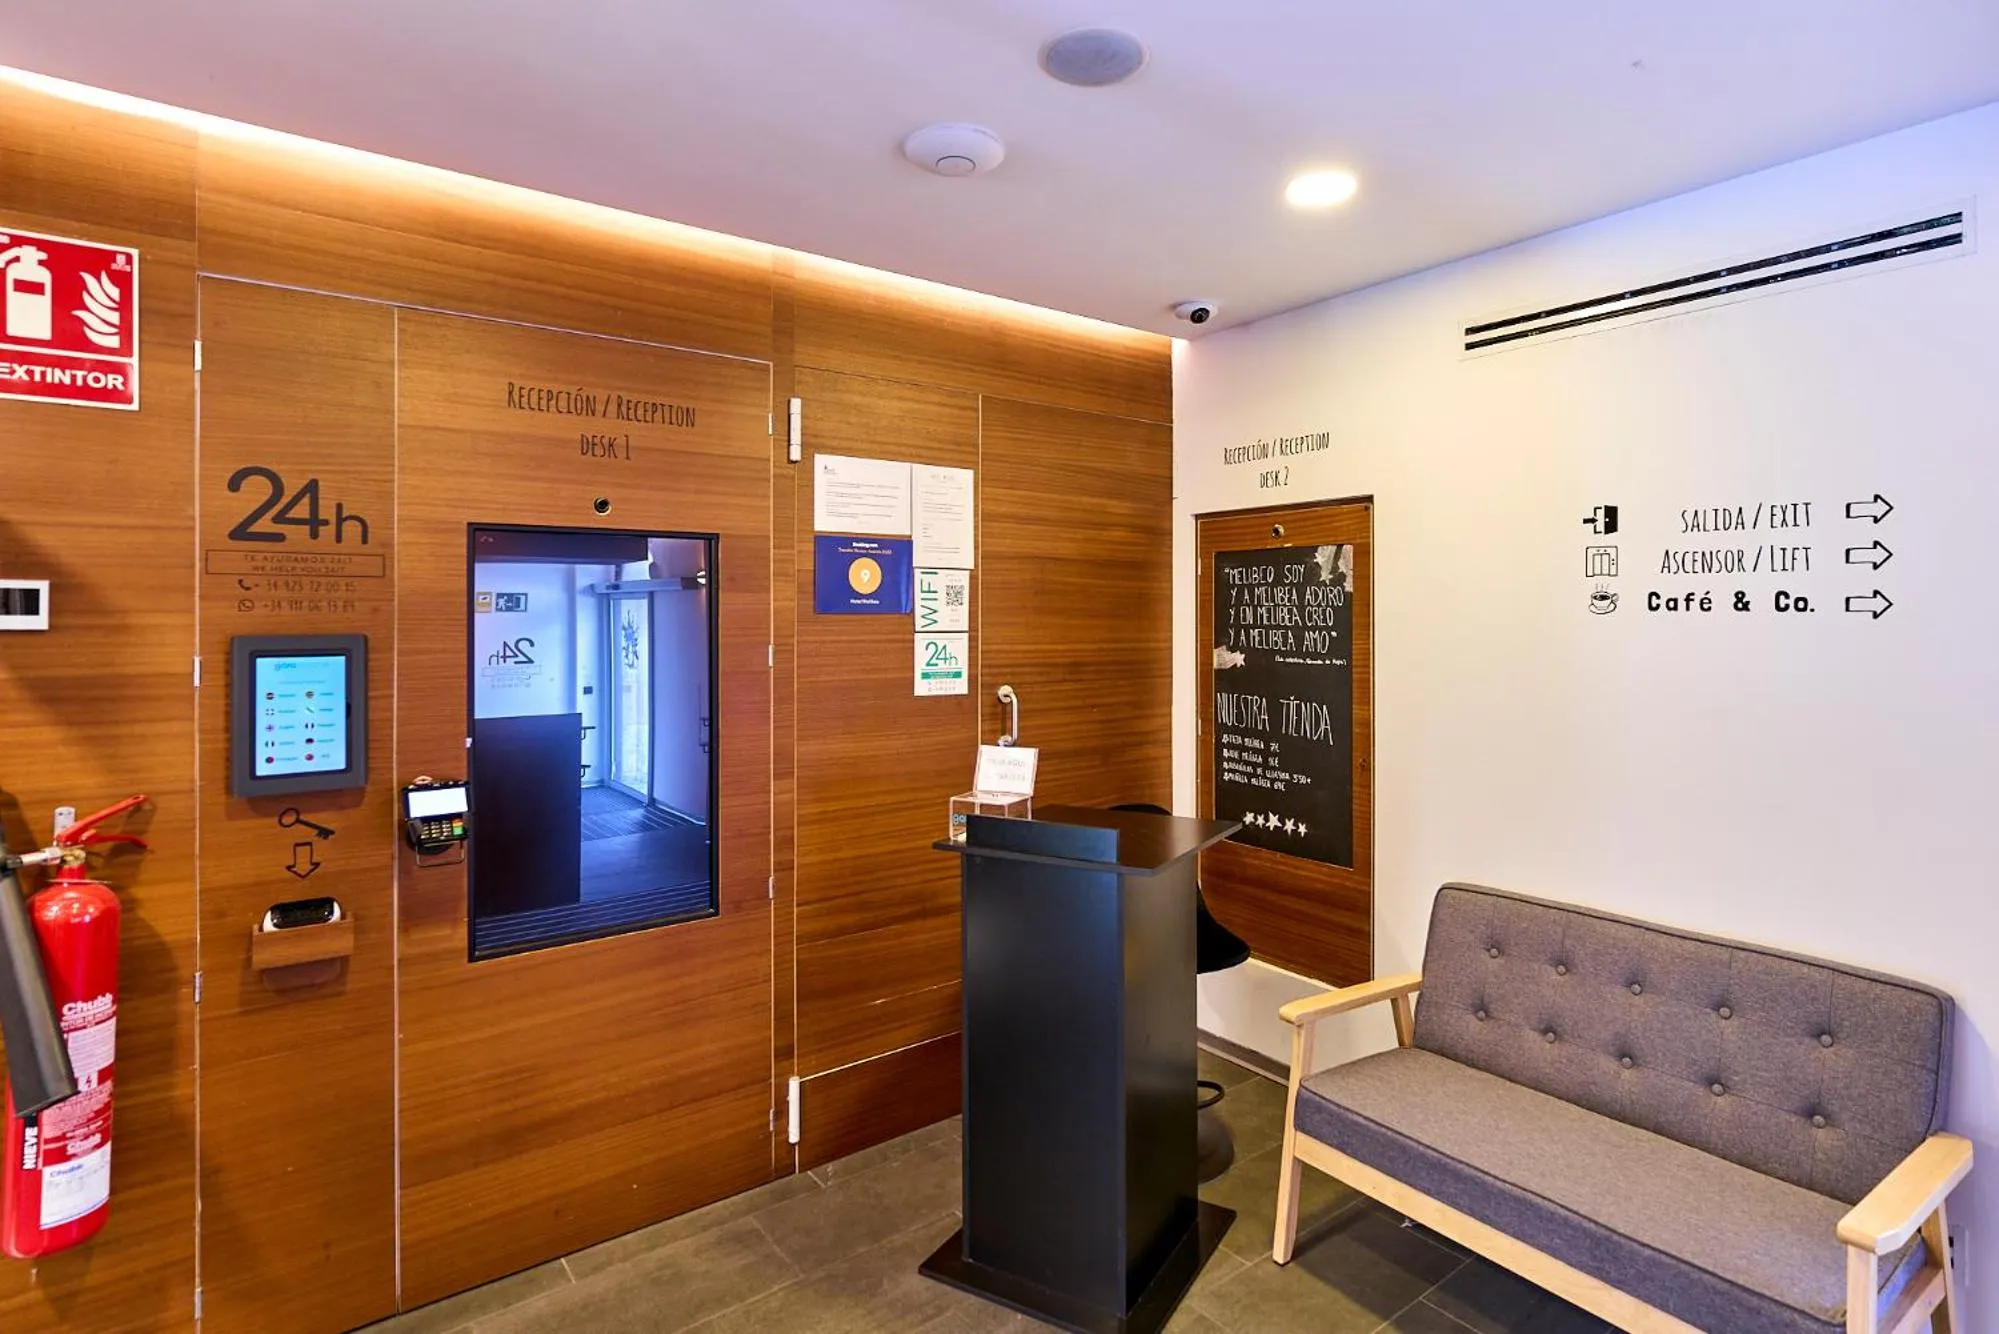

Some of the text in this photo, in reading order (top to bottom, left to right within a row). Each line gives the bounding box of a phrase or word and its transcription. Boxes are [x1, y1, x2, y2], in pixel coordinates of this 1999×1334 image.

[0, 362, 125, 390] EXTINTOR
[616, 394, 696, 428] RECEPTION
[580, 434, 632, 461] DESK 1
[1260, 466, 1289, 488] DESK 2
[227, 466, 369, 545] 24h
[1681, 506, 1746, 533] SALIDA
[1770, 502, 1812, 529] EXIT
[1661, 549, 1746, 575] ASCENSOR
[1770, 544, 1812, 572] LIFT
[1283, 564, 1305, 584] SOY
[920, 571, 938, 628] WIFI
[1230, 585, 1344, 607] Y A MELIBEA ADORO
[1647, 590, 1816, 613] Café & Co.
[1229, 607, 1235, 624] Y
[1257, 606, 1302, 627] MELIBEA
[1305, 607, 1334, 626] CREO
[1228, 627, 1235, 647] Y
[1239, 628, 1247, 647] A
[1250, 628, 1296, 651] MELIBEA
[925, 641, 958, 667] 24h
[1217, 692, 1270, 732] NUESTRA
